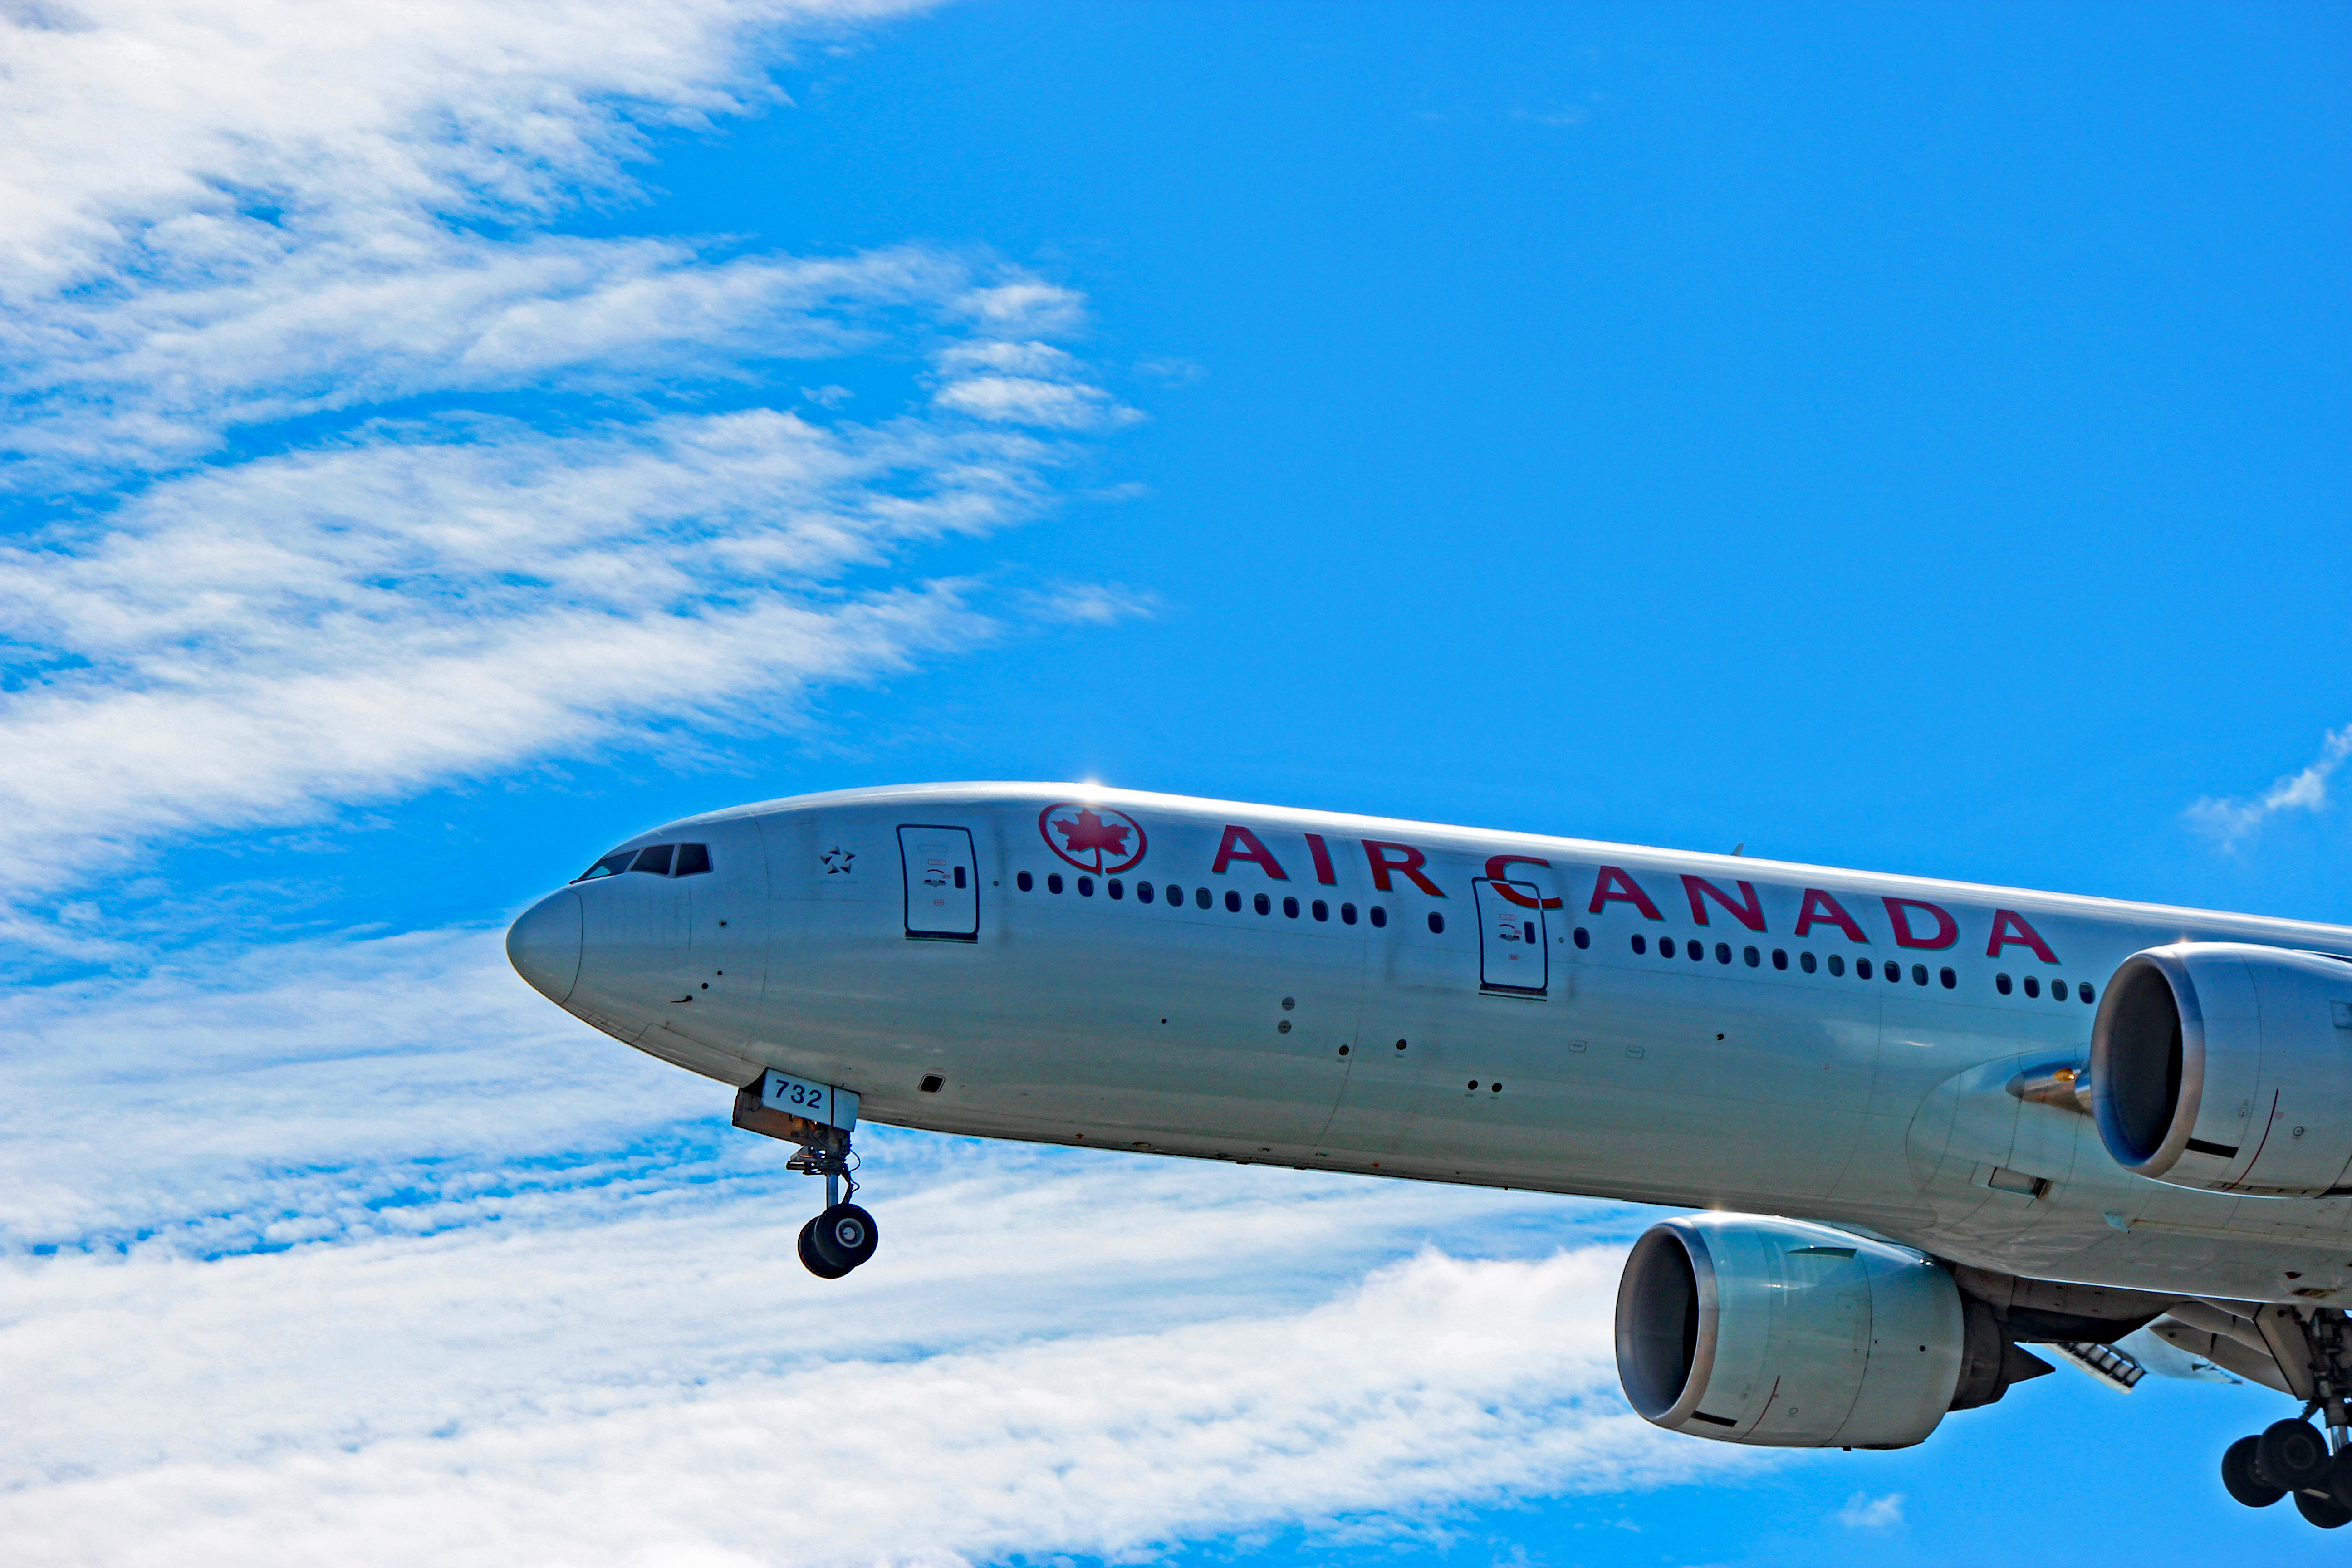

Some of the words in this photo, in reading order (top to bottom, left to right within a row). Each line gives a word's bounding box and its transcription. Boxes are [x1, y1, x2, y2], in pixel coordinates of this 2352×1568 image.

[1212, 825, 1447, 897] AIR
[1485, 855, 2060, 964] CANADA
[776, 1079, 822, 1109] 732
